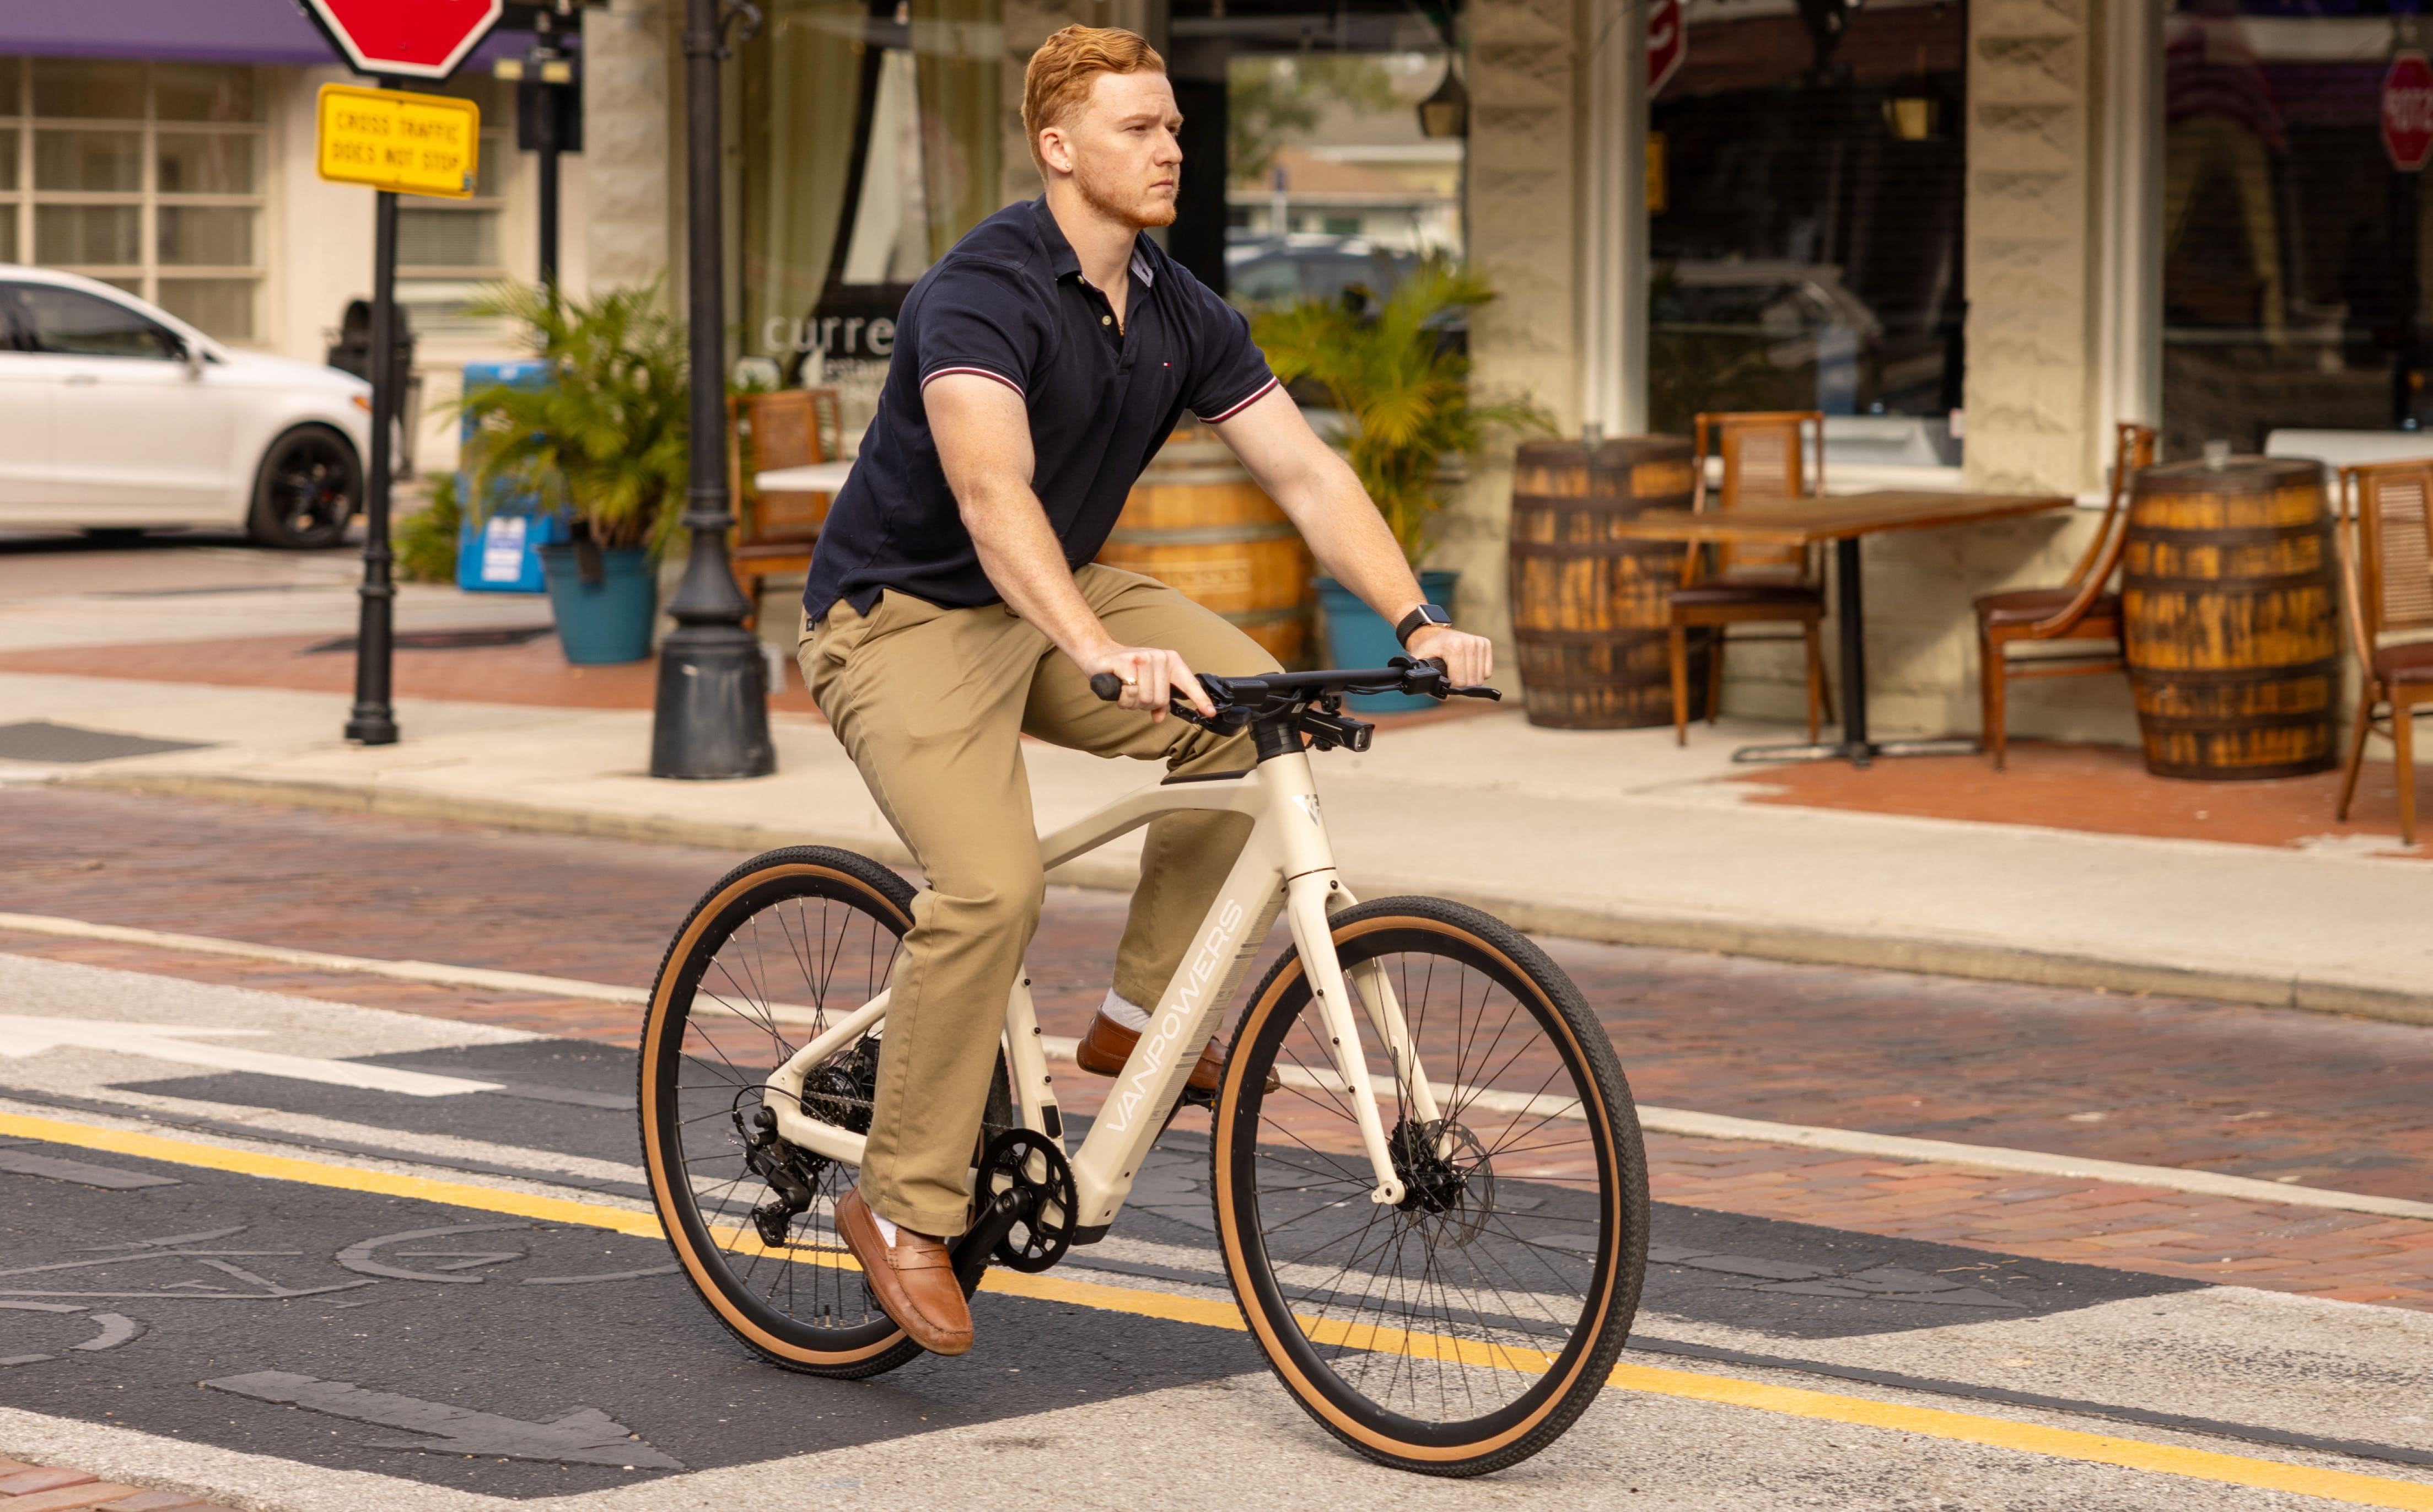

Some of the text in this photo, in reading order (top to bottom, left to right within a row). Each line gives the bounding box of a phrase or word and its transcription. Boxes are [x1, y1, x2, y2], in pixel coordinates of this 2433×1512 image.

[335, 110, 458, 144] CROSS TRAFFIC
[331, 139, 459, 173] DOES NOT STOP
[1106, 899, 1242, 1133] VANPOWERS
